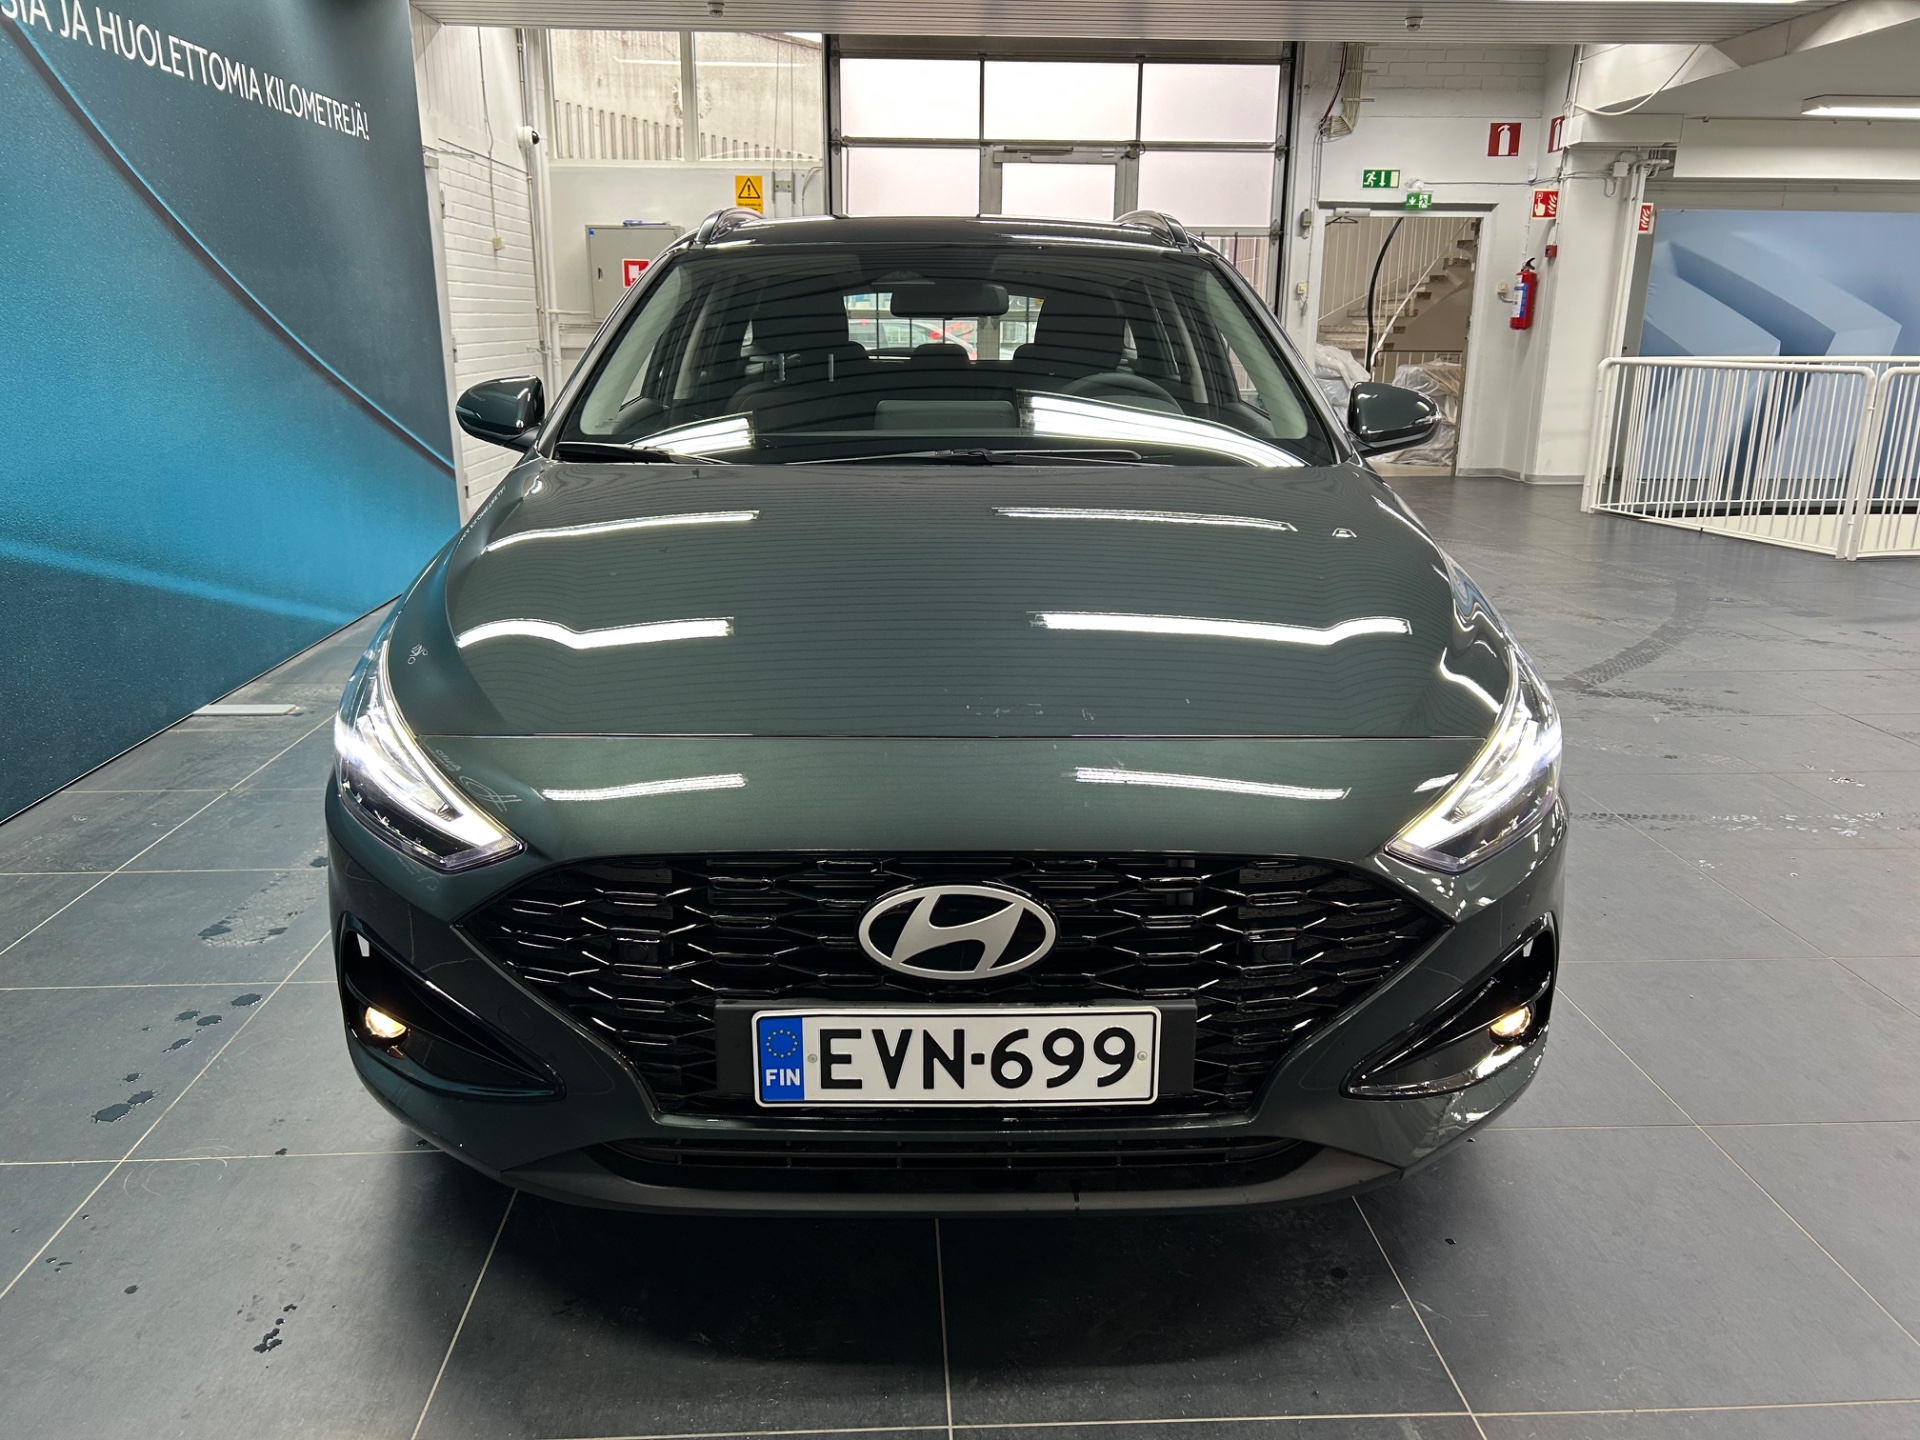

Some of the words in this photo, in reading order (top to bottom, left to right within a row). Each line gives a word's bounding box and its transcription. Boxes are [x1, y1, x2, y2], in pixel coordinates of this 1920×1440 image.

[60, 0, 94, 46] JA
[95, 6, 263, 105] HUOLETTOMIA
[263, 72, 370, 140] KILOMETREJÄ!
[765, 1068, 801, 1087] FIN
[818, 1026, 1136, 1090] EVN-699
